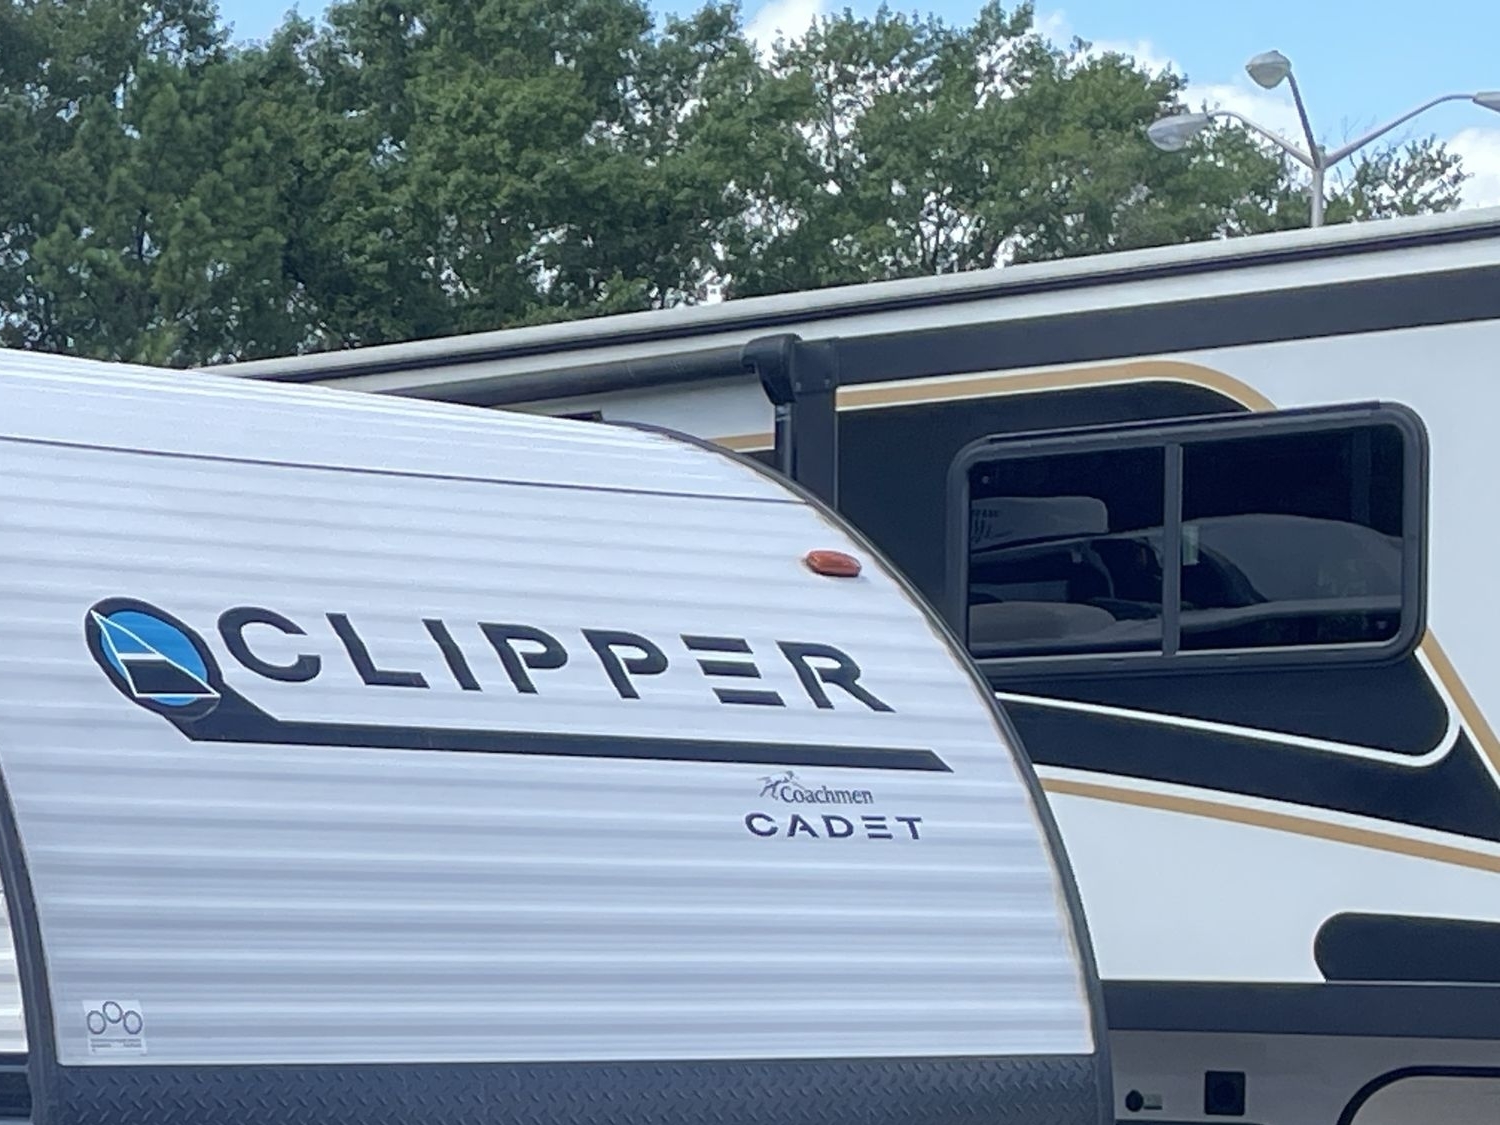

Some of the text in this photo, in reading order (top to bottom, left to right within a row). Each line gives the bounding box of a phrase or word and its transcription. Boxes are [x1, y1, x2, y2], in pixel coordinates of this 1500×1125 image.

[217, 605, 897, 713] CLIPPER
[779, 784, 875, 805] Coachmen
[744, 812, 923, 841] CADET
